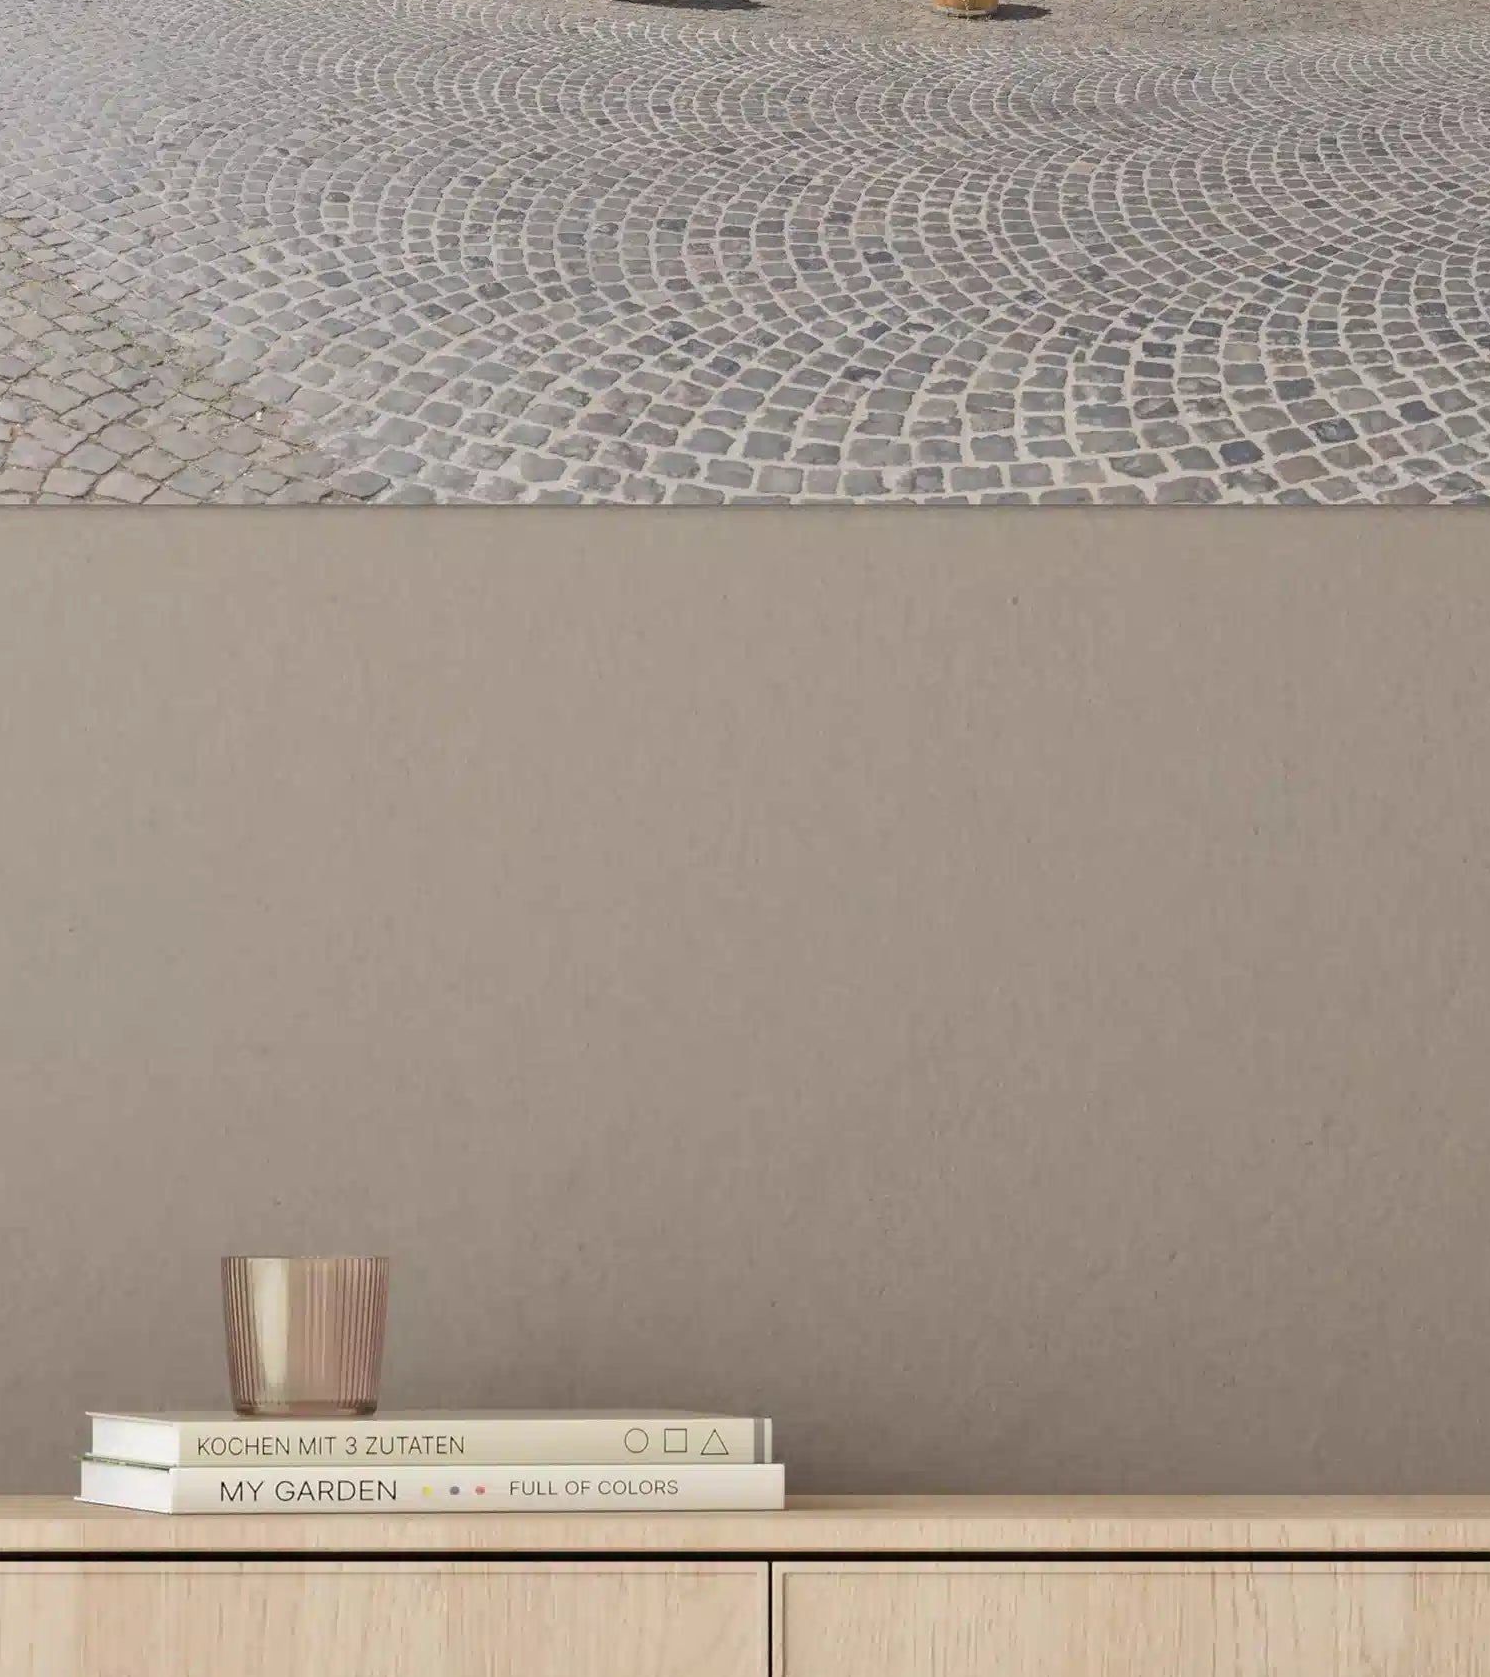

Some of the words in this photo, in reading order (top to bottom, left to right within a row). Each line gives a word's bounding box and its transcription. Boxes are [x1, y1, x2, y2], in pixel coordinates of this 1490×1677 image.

[197, 1436, 290, 1456] KOCHEN
[299, 1436, 336, 1455] MIT
[345, 1436, 358, 1456] 3
[365, 1435, 465, 1455] ZUTATEN
[220, 1480, 264, 1502] MY
[275, 1479, 398, 1502] GARDEN
[509, 1480, 557, 1496] FULL
[565, 1479, 591, 1496] OF
[597, 1479, 679, 1496] COLORS
